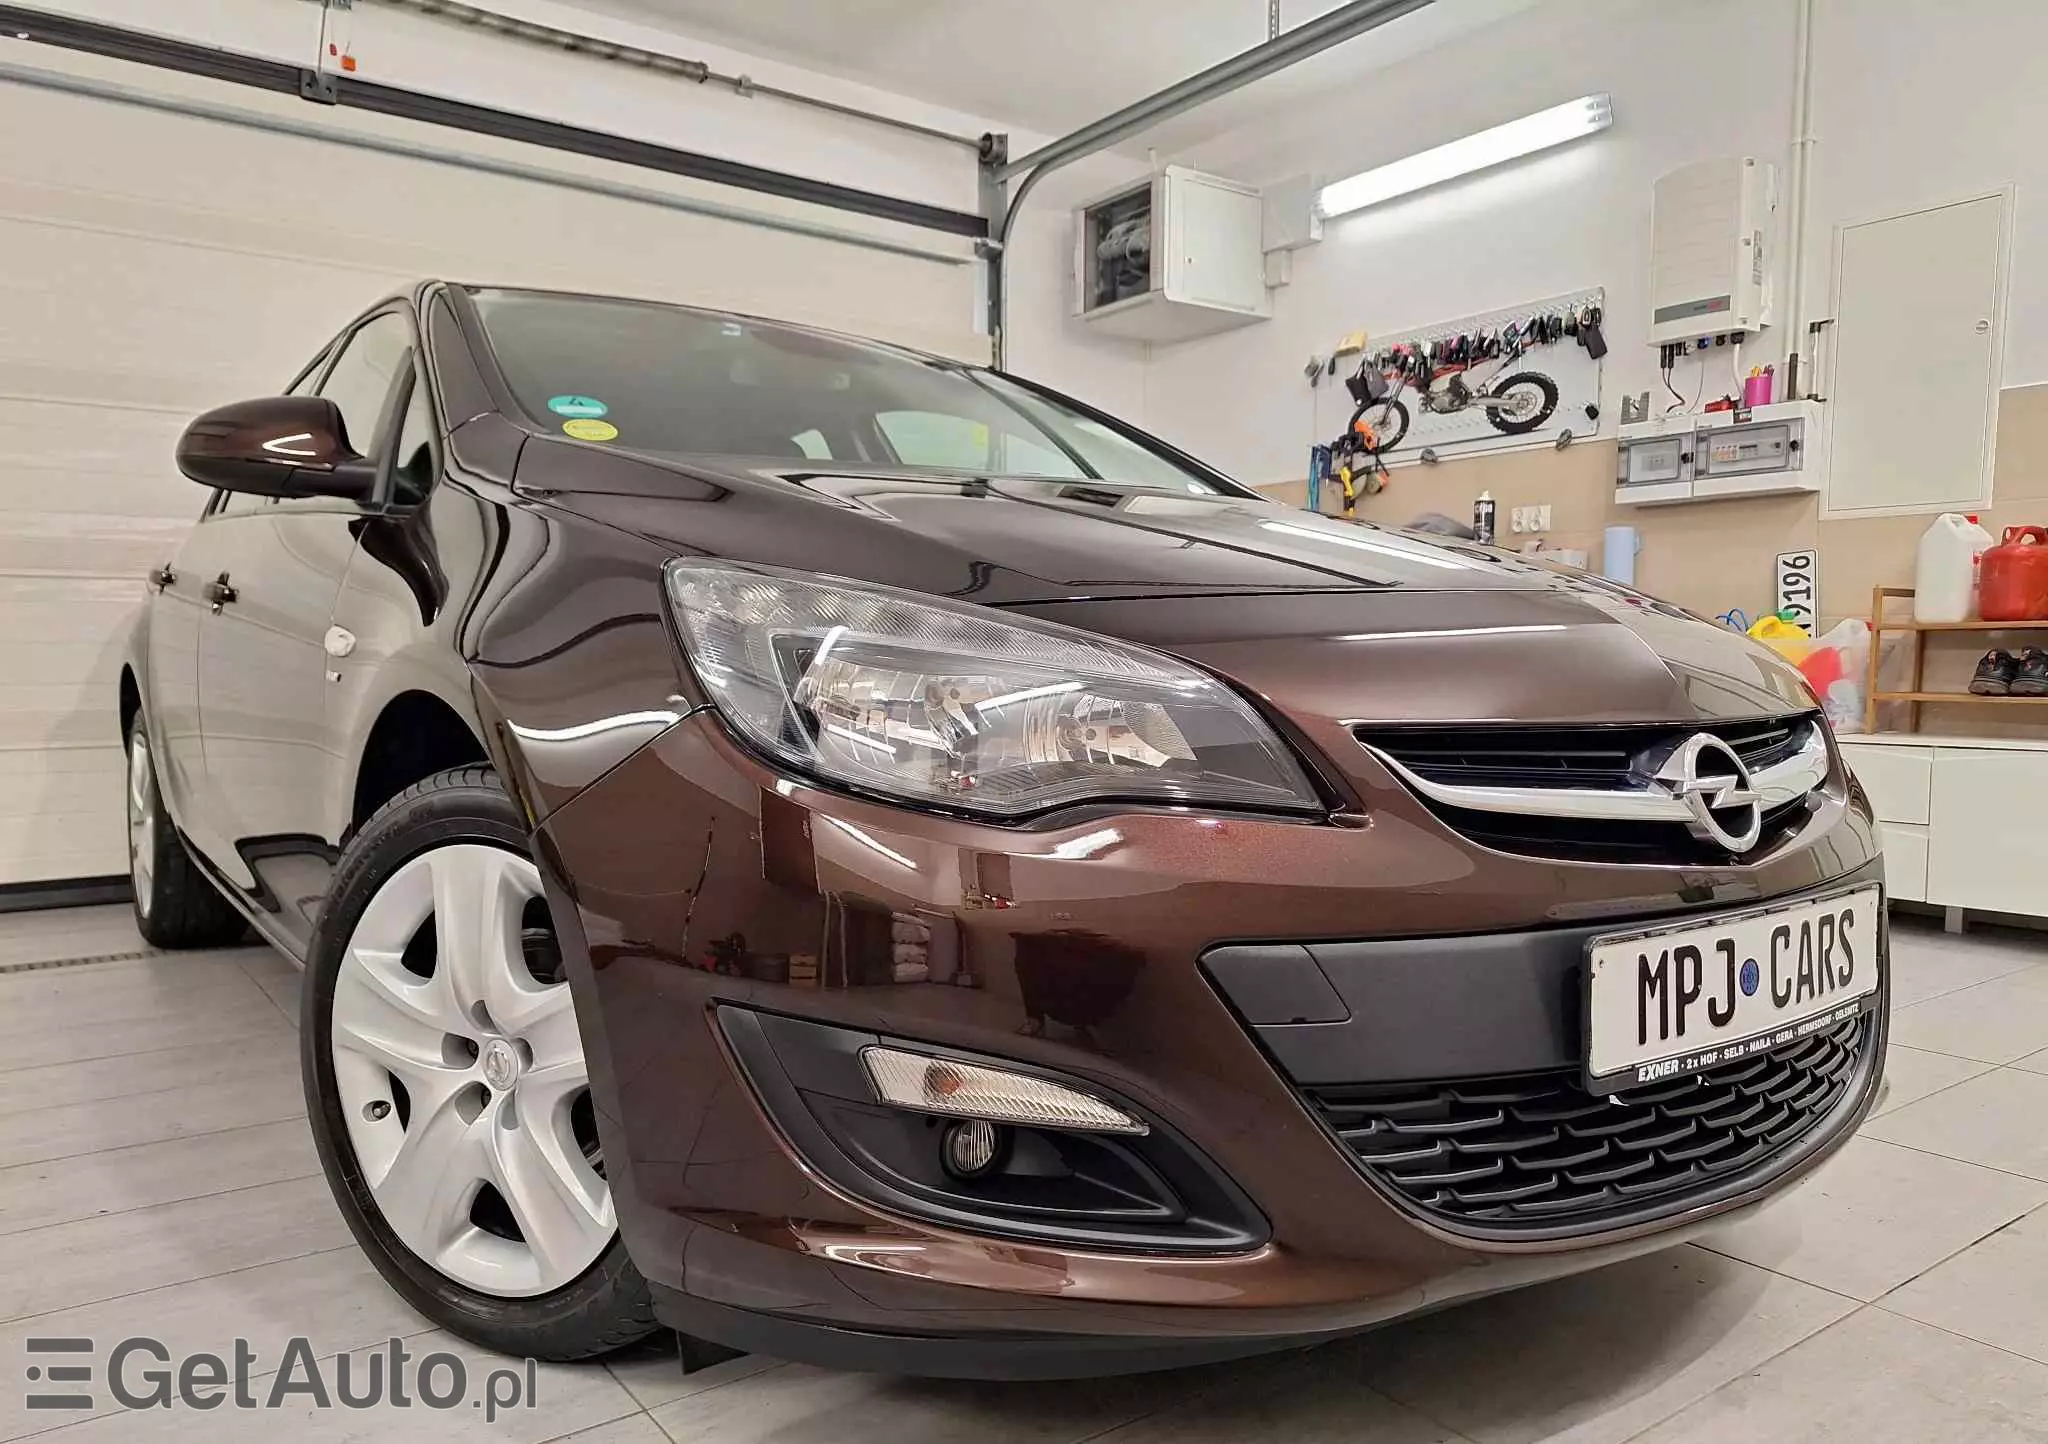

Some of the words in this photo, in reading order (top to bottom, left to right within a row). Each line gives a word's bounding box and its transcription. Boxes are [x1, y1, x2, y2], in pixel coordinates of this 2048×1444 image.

[1638, 938, 1736, 1045] MPJ
[1770, 908, 1854, 1008] CARS
[1638, 1059, 1679, 1082] EXNER
[1686, 1058, 1698, 1070] 2x
[1700, 1051, 1718, 1066] HOF
[1724, 1045, 1744, 1060] SELB
[1750, 1037, 1771, 1052] NAILA
[1776, 1029, 1793, 1044] GERA
